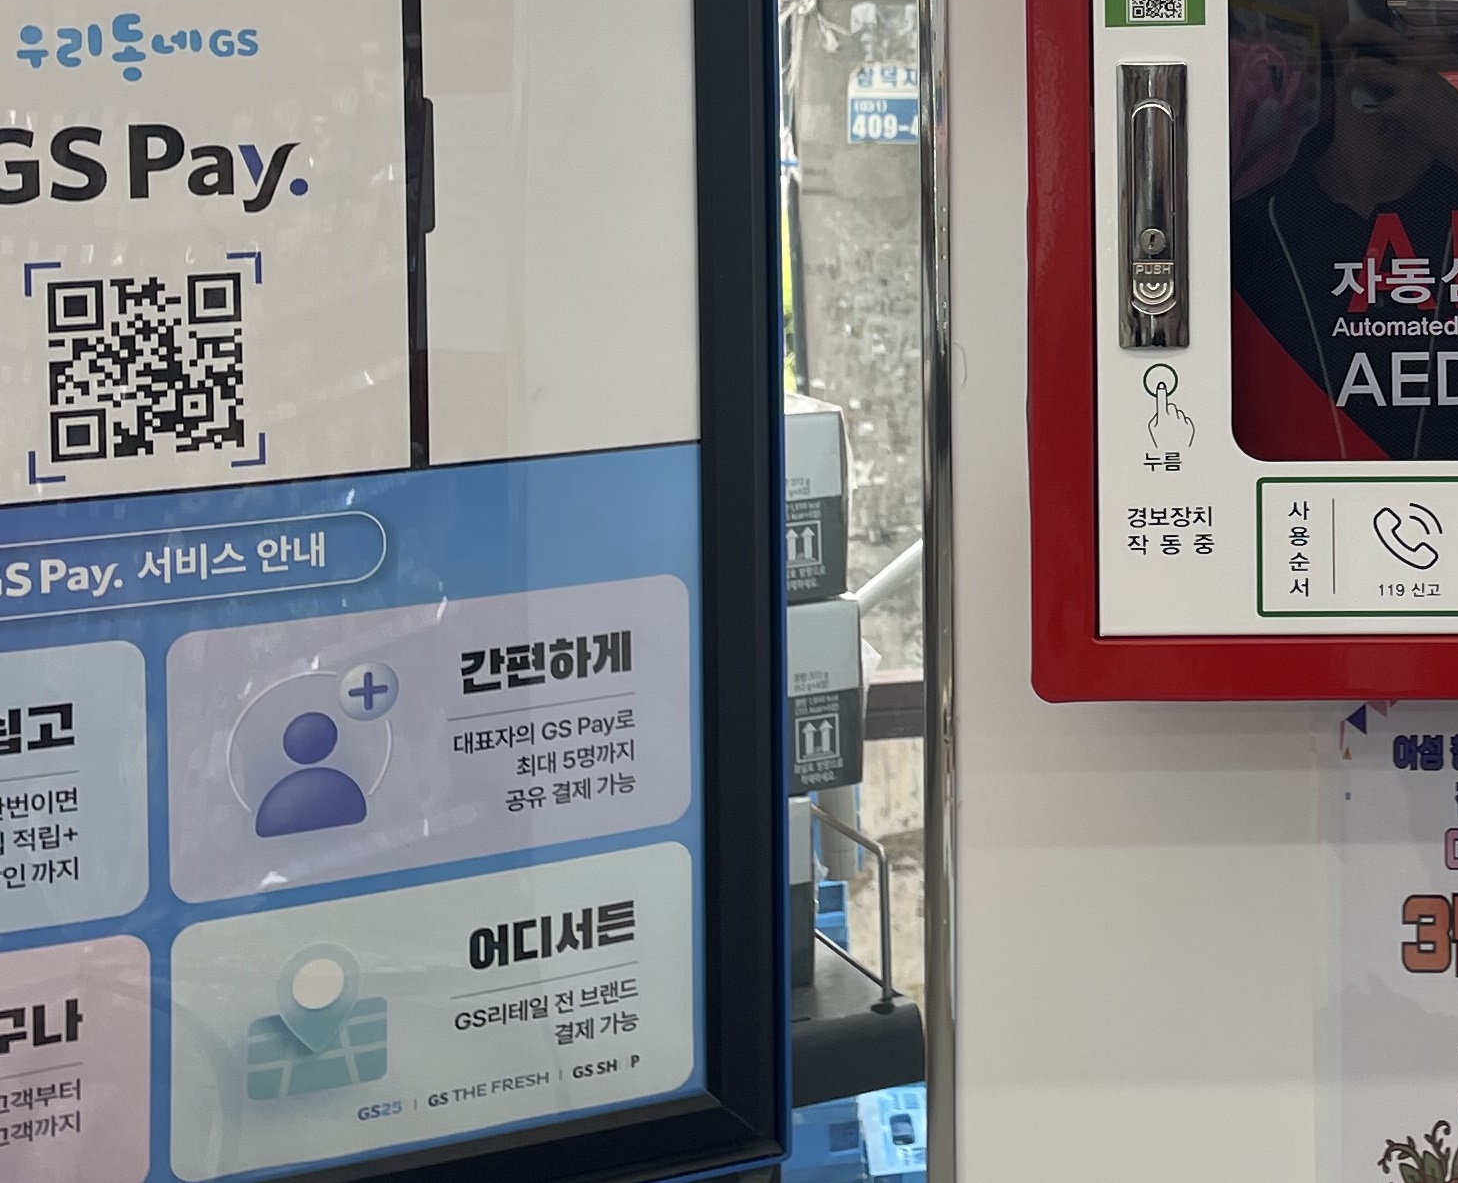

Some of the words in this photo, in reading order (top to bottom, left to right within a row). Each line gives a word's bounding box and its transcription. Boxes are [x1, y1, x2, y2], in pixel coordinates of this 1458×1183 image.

[0, 126, 107, 206] GS
[128, 124, 309, 214] Pay.
[1135, 264, 1172, 276] PUSH
[1331, 315, 1458, 337] Automated
[1143, 452, 1182, 472] 누름
[1127, 506, 1212, 528] 경보장치
[40, 559, 123, 598] Pay.
[138, 540, 246, 585] 서비스
[257, 531, 327, 574] 안내
[1378, 583, 1405, 597] 119
[1411, 582, 1442, 598] 신고
[460, 629, 634, 696] 간편하게
[452, 720, 537, 756] 대표자의
[540, 717, 572, 744] GS
[576, 708, 637, 741] Pay로
[516, 748, 557, 780] 최대
[562, 738, 637, 773] 5명까지
[1393, 734, 1444, 771] 여성
[505, 781, 547, 813] 공유
[551, 776, 593, 807] 결제
[596, 770, 638, 800] 가능
[13, 823, 79, 854] 적립+
[31, 856, 80, 887] 까지
[469, 900, 637, 970] 어디서든
[454, 996, 550, 1031] GS리테일
[554, 990, 575, 1015] 전
[578, 978, 640, 1009] 브랜드
[554, 1017, 595, 1046] 결제
[599, 1010, 640, 1036] 가능
[572, 1063, 594, 1079] GS
[427, 1092, 449, 1109] GS
[451, 1083, 488, 1103] THE
[491, 1071, 551, 1095] FRESH
[357, 1100, 403, 1121] GS25
